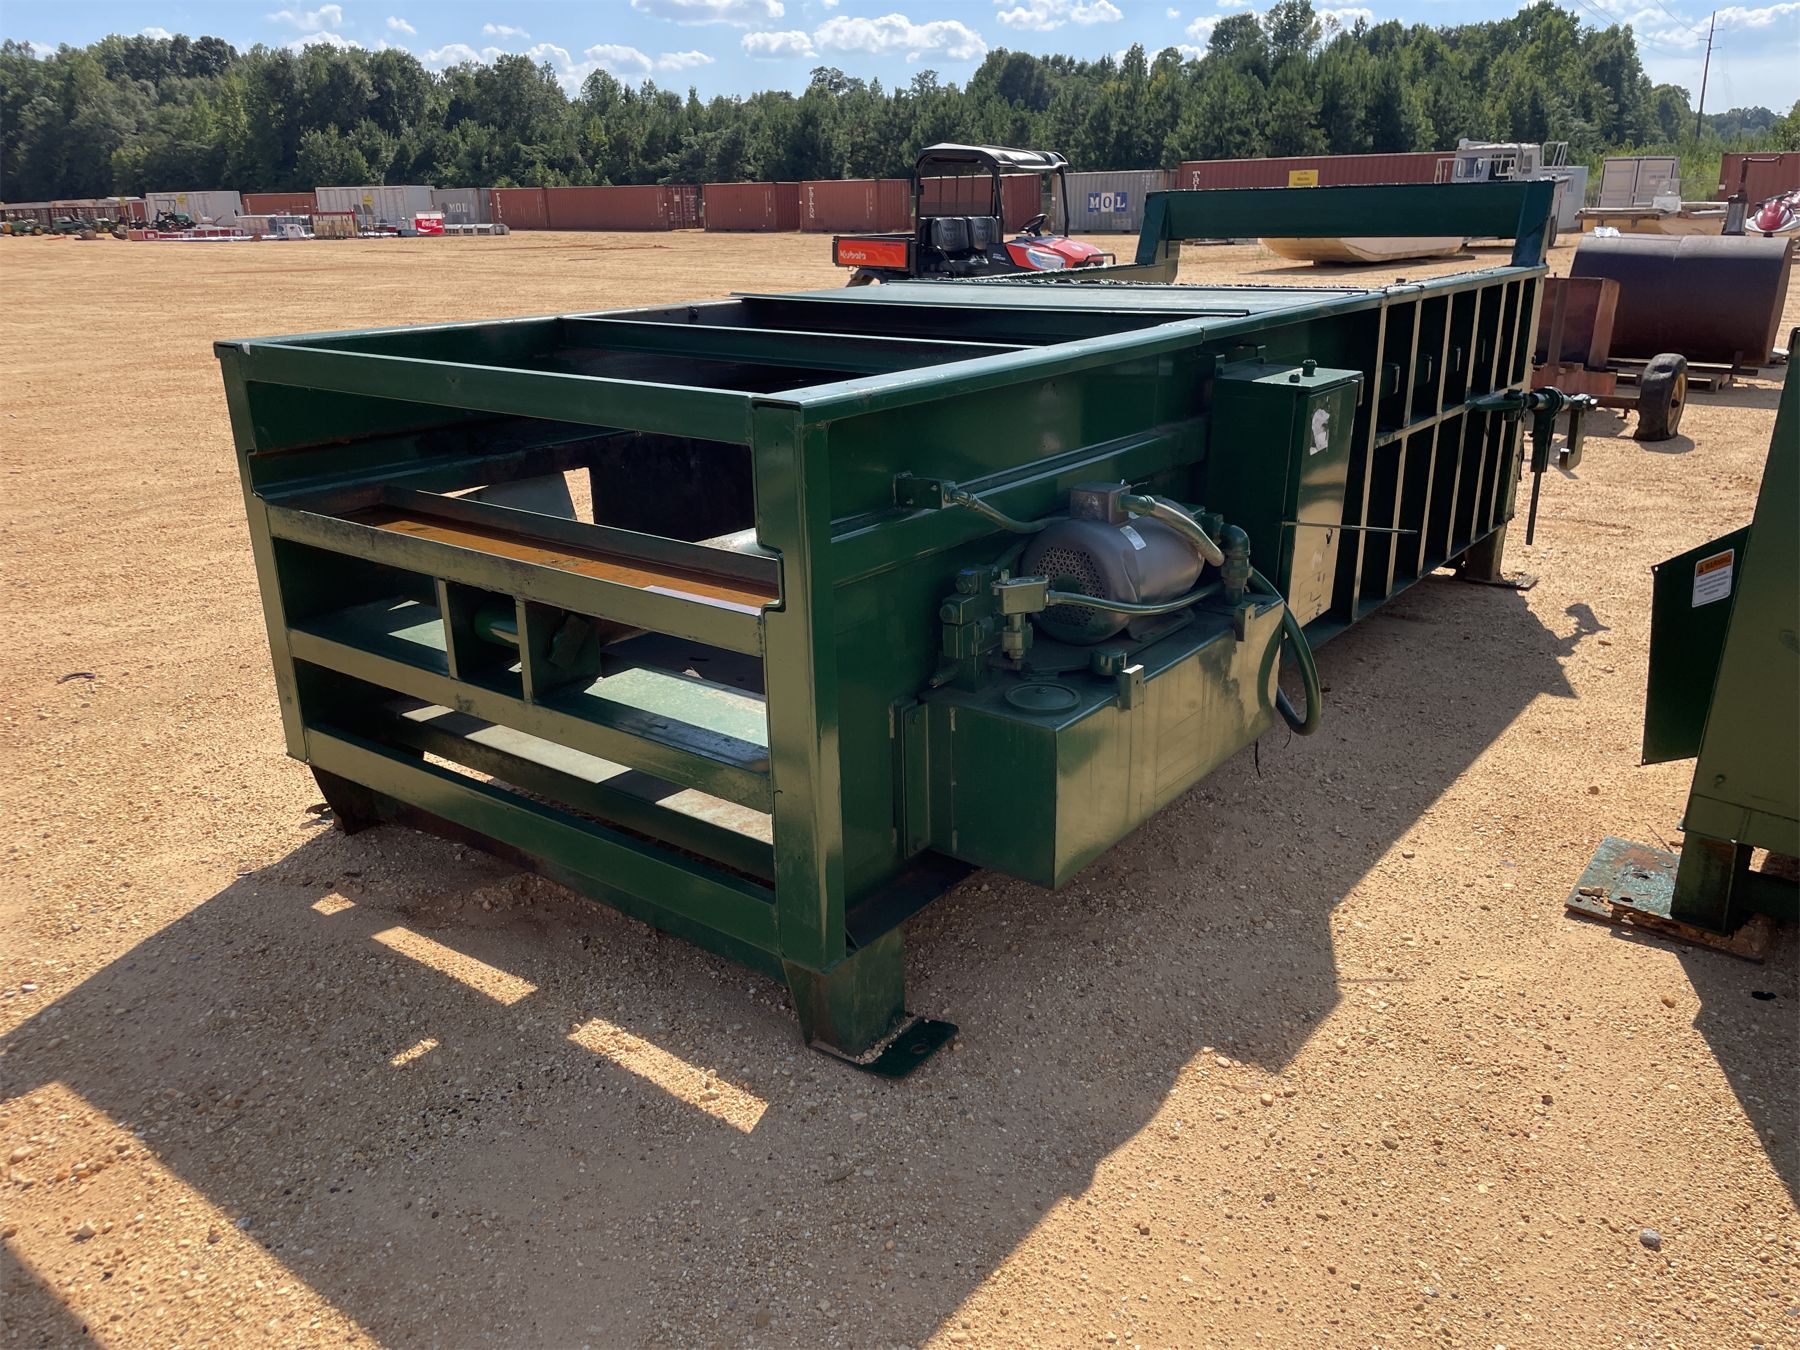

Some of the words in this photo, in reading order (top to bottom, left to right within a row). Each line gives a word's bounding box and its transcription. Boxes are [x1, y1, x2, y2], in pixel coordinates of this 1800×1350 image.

[448, 202, 468, 213] MOL
[1089, 195, 1126, 209] MOL
[840, 250, 866, 260] Kubota
